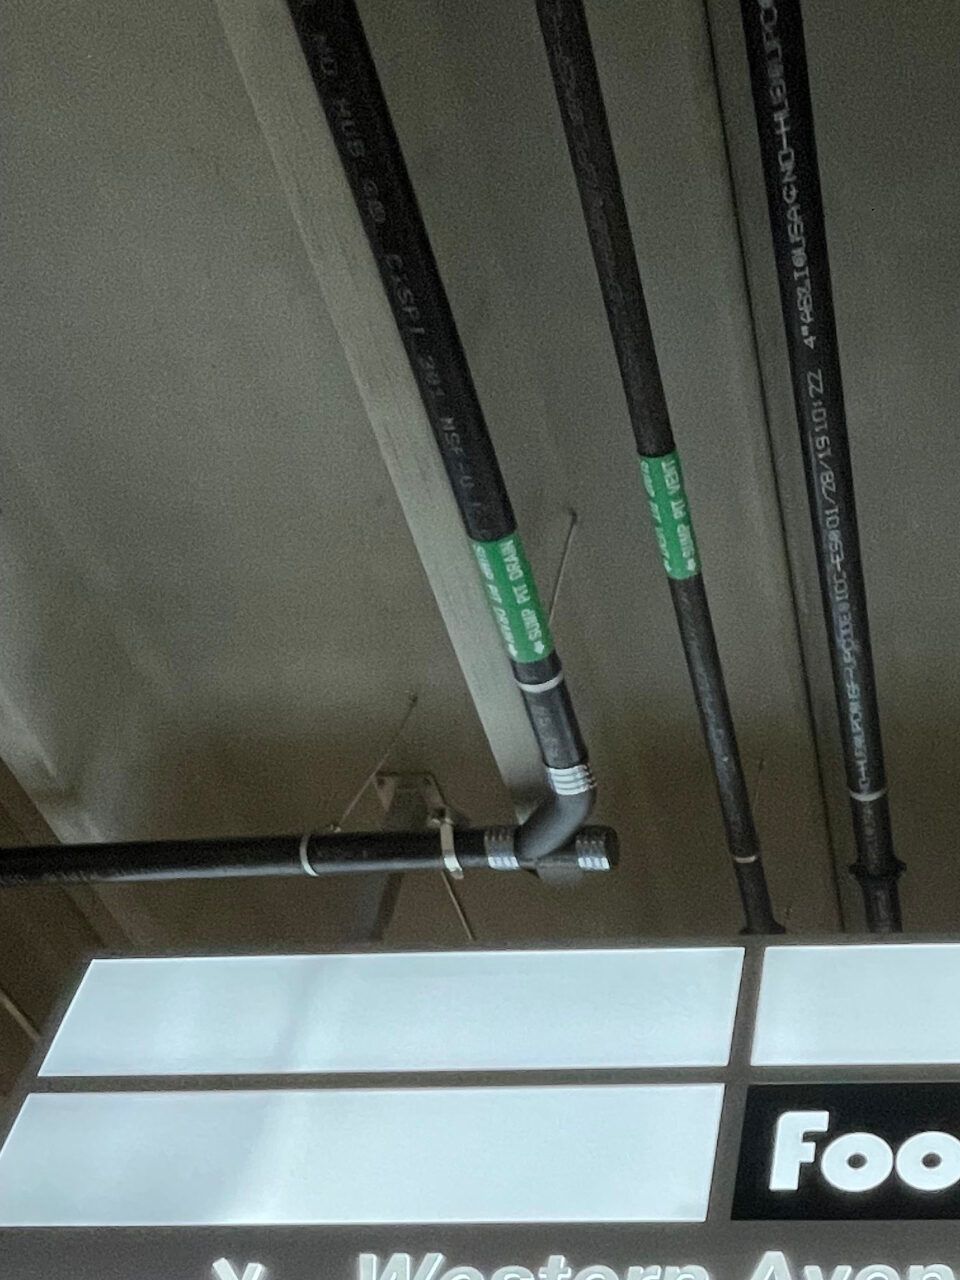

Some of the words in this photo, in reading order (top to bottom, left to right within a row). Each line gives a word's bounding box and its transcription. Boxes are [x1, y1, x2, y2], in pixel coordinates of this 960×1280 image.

[501, 540, 524, 581] DRAIN
[512, 584, 531, 604] PIT
[521, 609, 543, 641] SUMP
